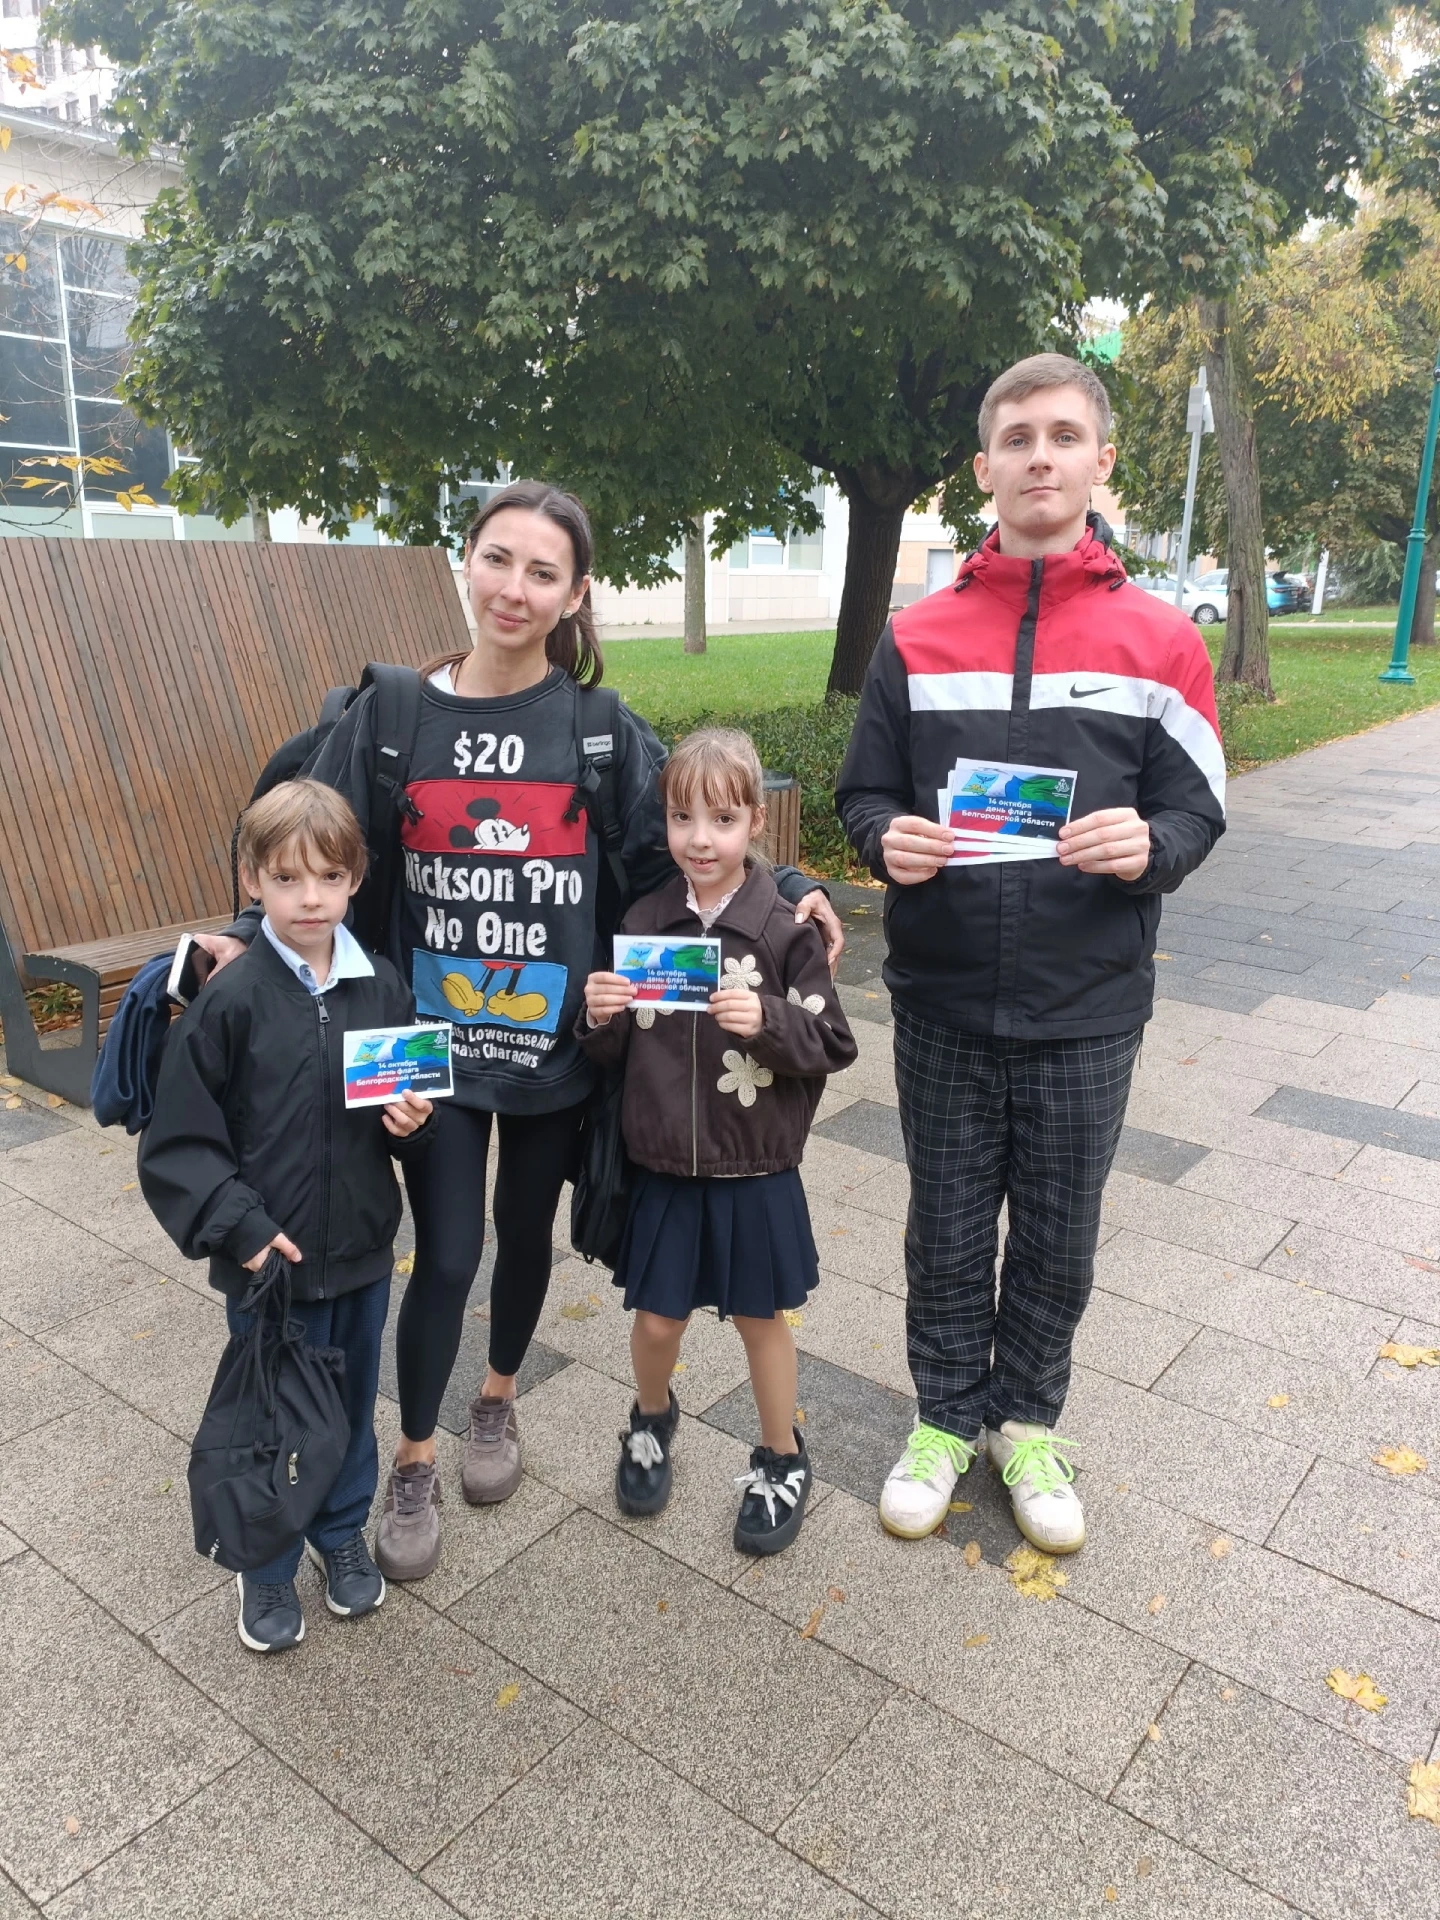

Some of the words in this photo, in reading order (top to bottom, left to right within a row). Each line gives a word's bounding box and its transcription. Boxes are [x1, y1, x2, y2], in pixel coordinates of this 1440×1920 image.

[453, 731, 525, 775] $20
[998, 800, 1032, 809] октября
[985, 806, 1006, 814] день
[1007, 808, 1032, 817] флага
[961, 810, 1020, 823] Белгородской
[1021, 818, 1055, 828] области
[521, 859, 583, 904] Pro
[476, 911, 547, 957] One
[656, 970, 687, 978] октября
[665, 977, 688, 985] флага
[678, 984, 709, 993] области
[387, 1060, 418, 1069] октября
[396, 1067, 419, 1076] флага
[356, 1074, 409, 1086] Белгородской
[410, 1072, 441, 1080] области
